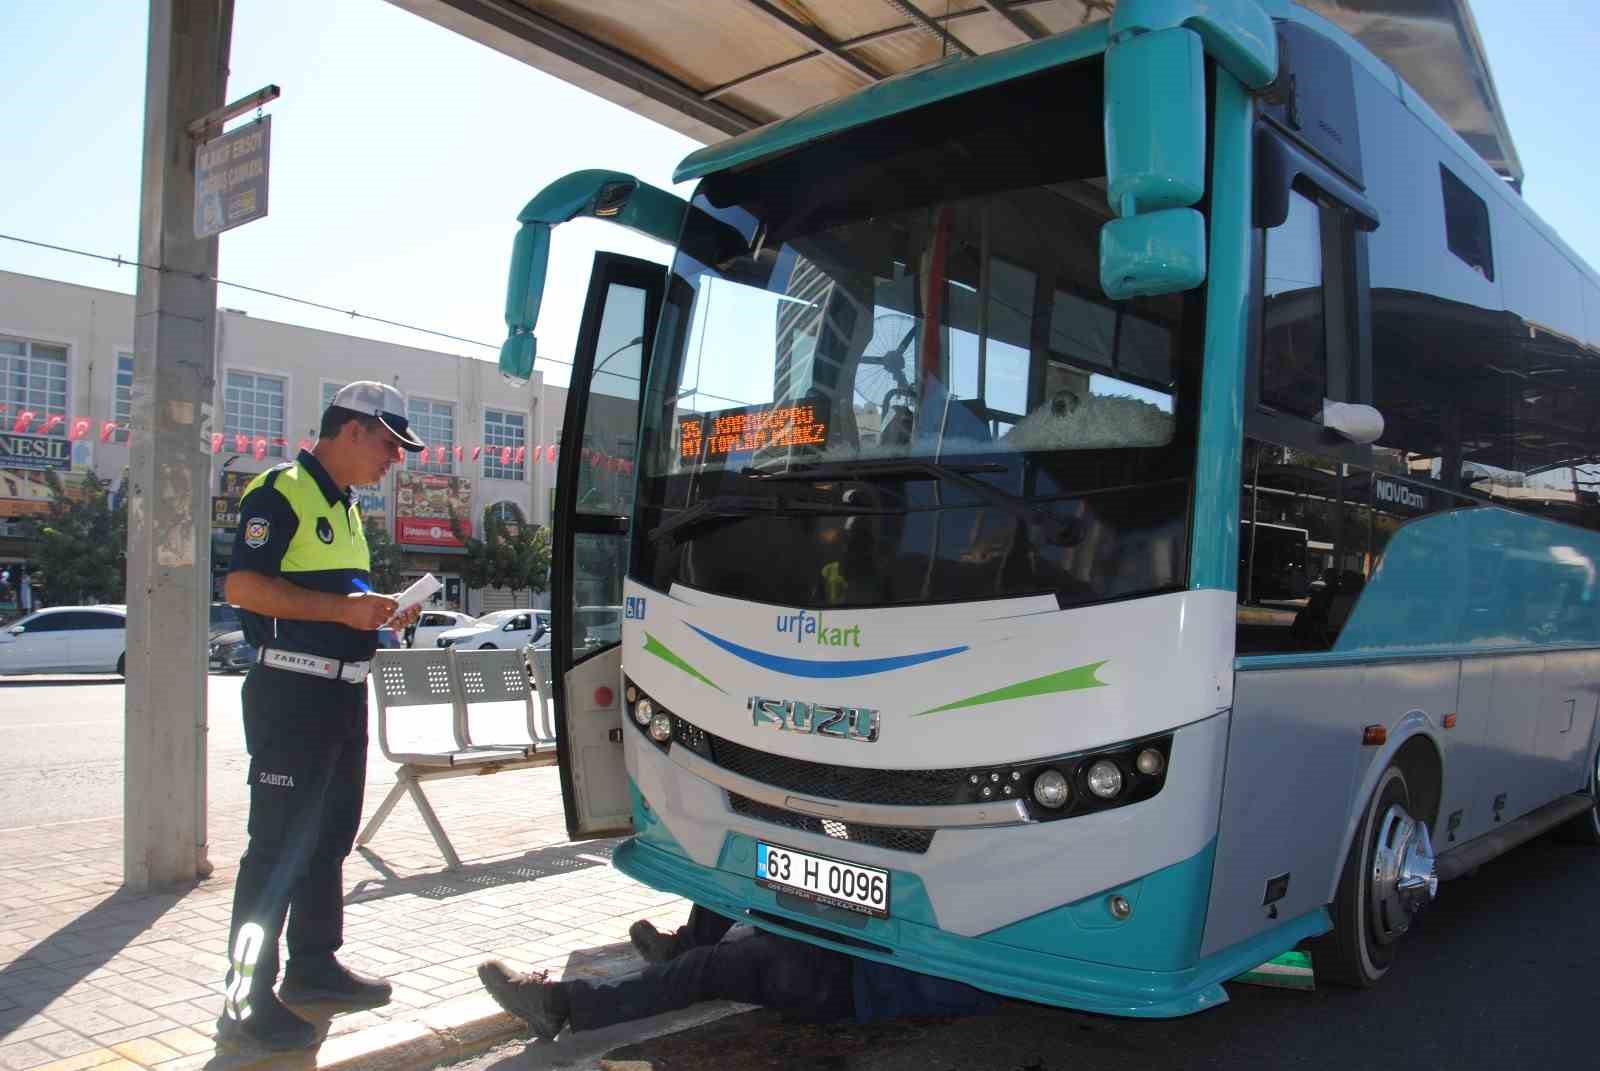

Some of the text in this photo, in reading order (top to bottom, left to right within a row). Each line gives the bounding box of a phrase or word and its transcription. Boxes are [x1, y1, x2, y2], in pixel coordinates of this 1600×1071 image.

[273, 653, 316, 667] ZABITA
[747, 696, 881, 743] ISUZU
[259, 771, 295, 787] ZABITA
[767, 850, 792, 881] 63
[804, 858, 819, 889] H
[828, 865, 884, 905] 0096
